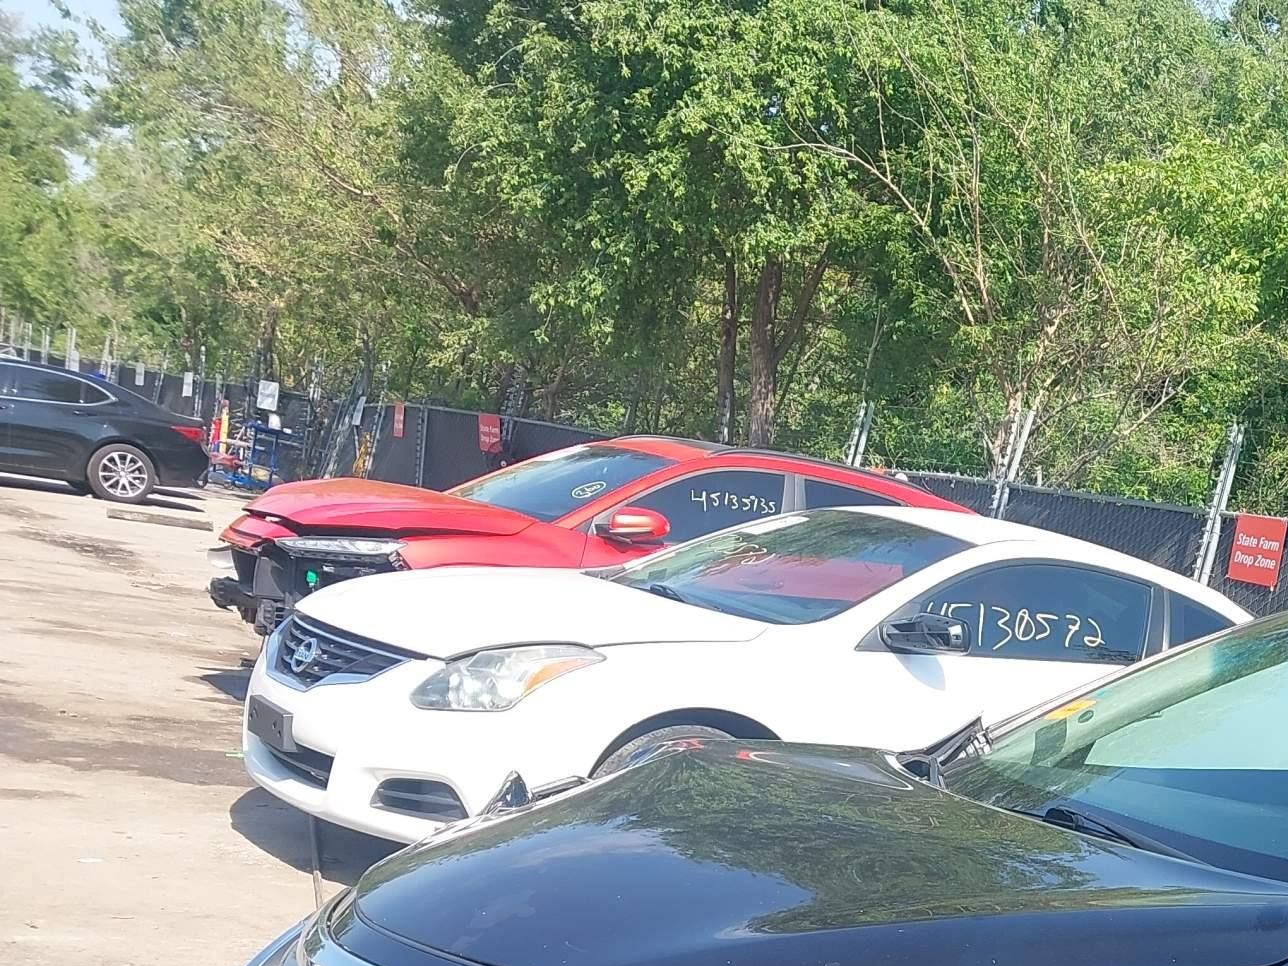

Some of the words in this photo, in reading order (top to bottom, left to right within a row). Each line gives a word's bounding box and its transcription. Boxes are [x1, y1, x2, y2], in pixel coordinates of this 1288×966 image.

[1237, 533, 1258, 548] State
[1259, 536, 1280, 552] Farm
[1234, 551, 1254, 568] Drop
[1254, 555, 1276, 569] Zone
